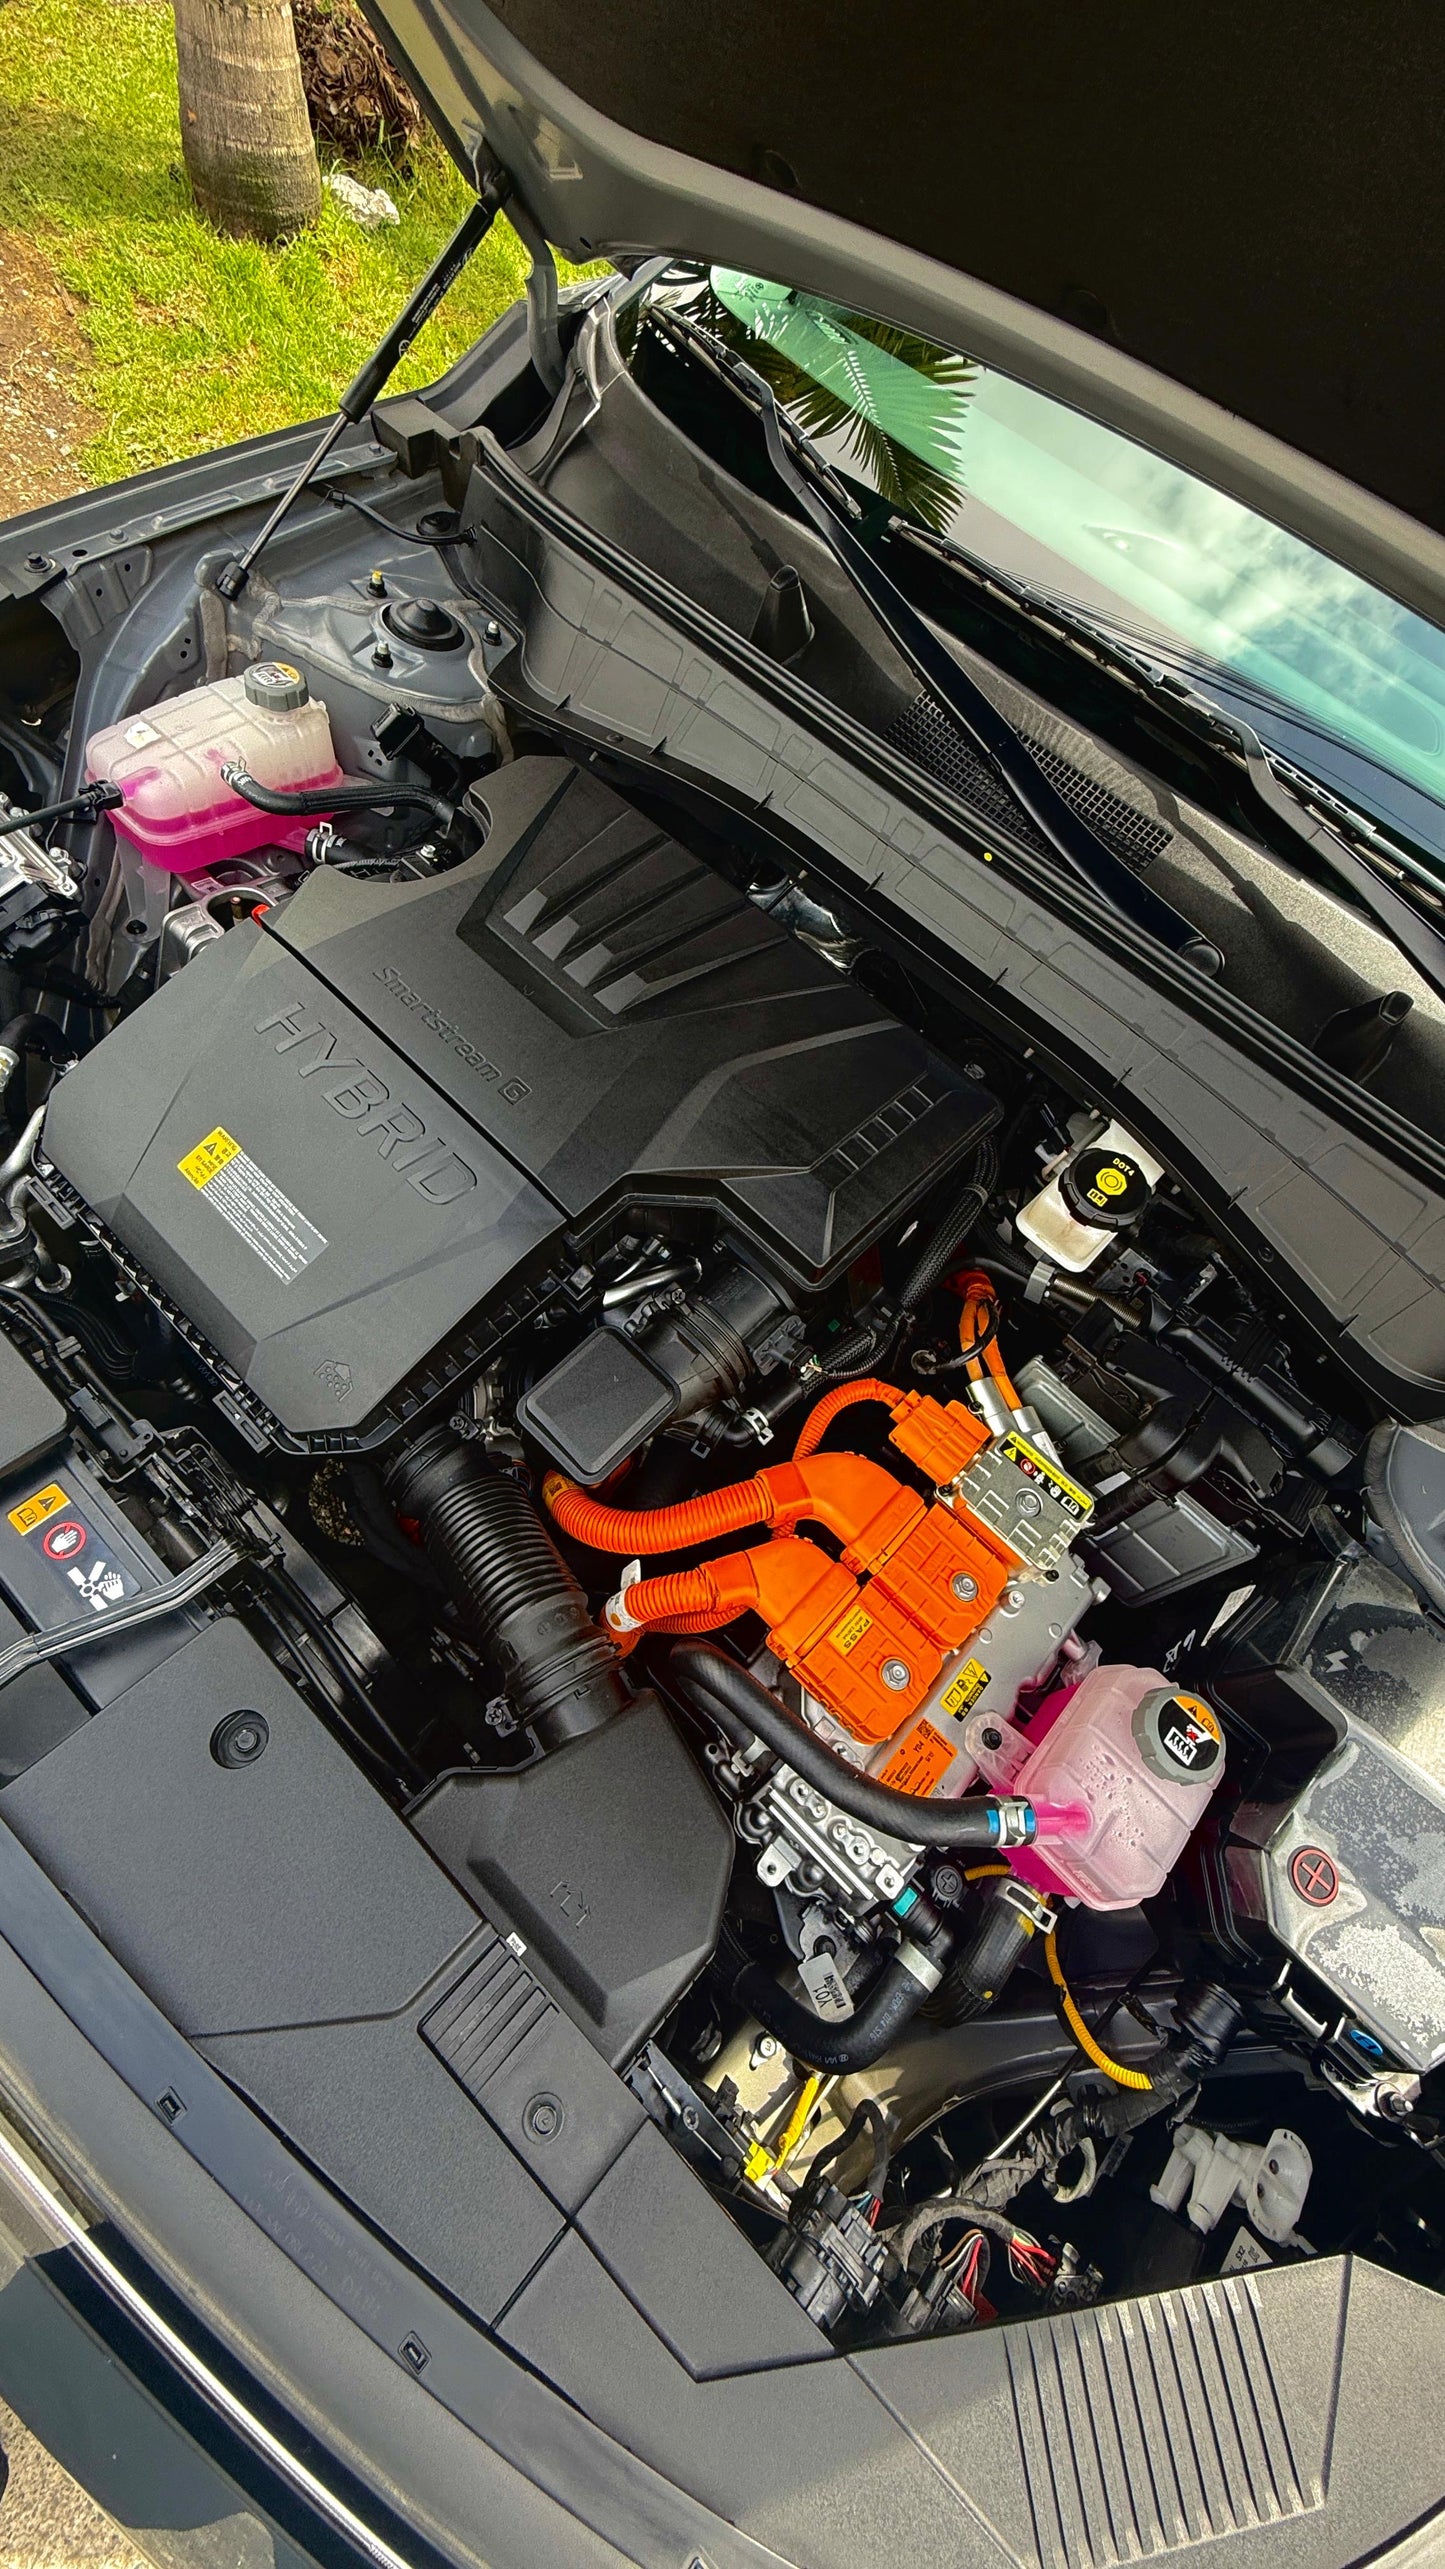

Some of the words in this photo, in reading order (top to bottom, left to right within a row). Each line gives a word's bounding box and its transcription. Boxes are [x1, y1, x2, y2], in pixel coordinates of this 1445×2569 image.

[372, 965, 502, 1082] Smartstream
[254, 1001, 478, 1205] HYBRID
[1112, 1158, 1135, 1176] DOT4
[843, 1618, 870, 1649] PASS
